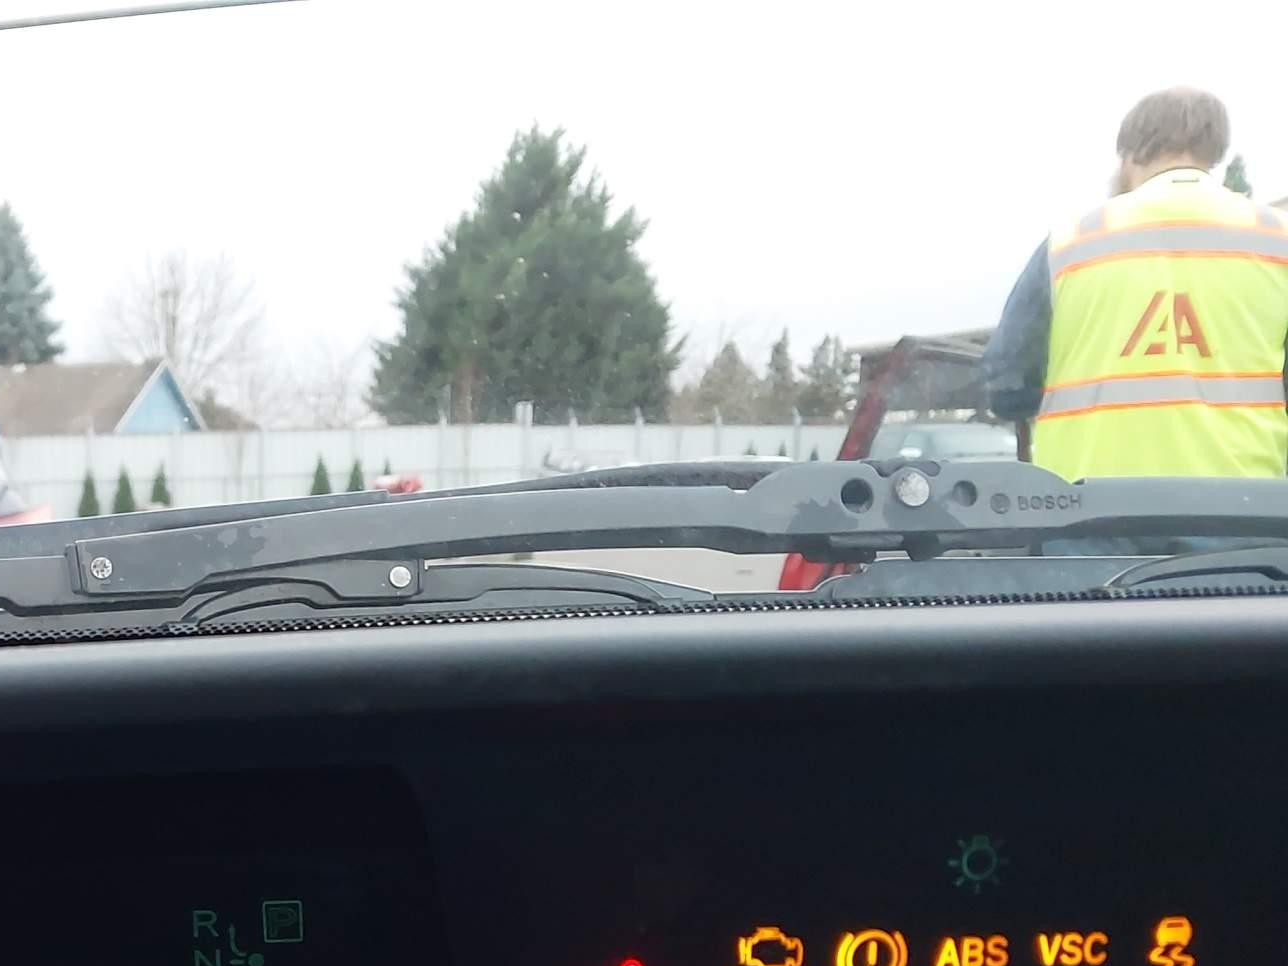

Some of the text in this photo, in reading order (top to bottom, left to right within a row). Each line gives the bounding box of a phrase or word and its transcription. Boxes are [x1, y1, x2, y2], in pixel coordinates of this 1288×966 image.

[1017, 494, 1082, 511] BOSCH
[192, 909, 219, 938] R
[267, 907, 296, 938] P
